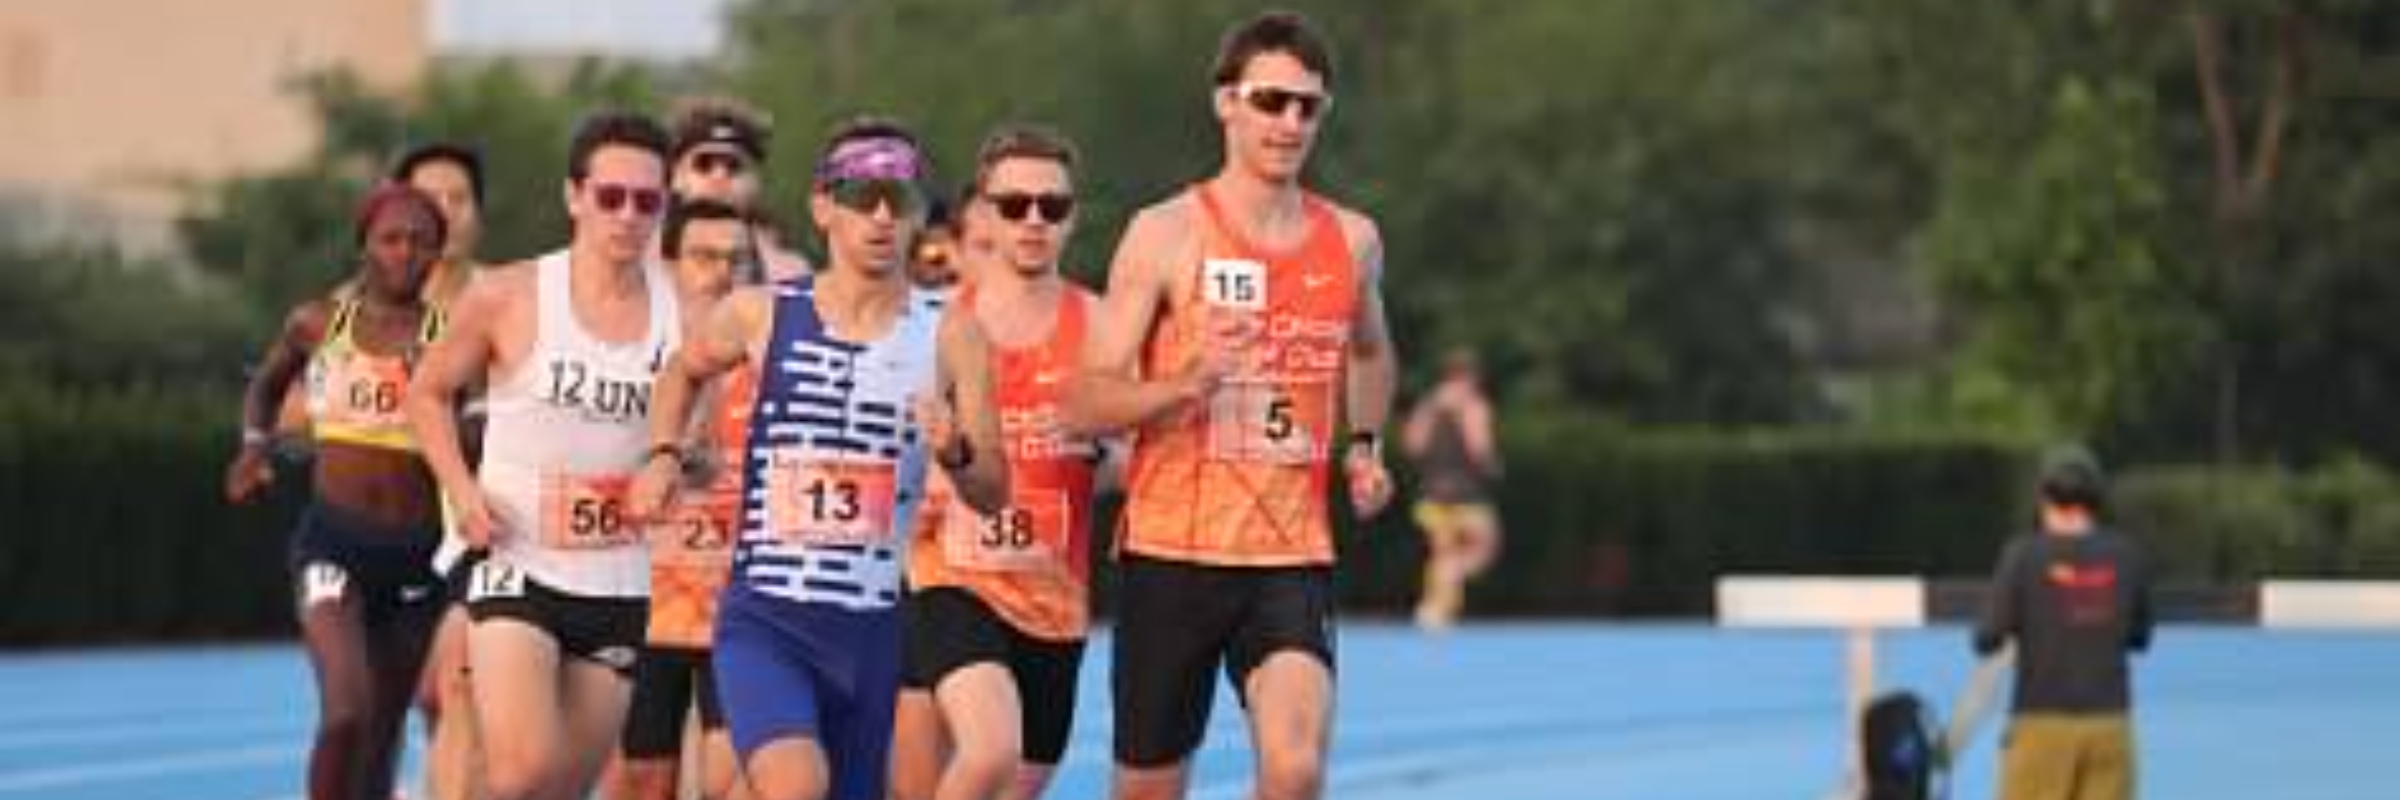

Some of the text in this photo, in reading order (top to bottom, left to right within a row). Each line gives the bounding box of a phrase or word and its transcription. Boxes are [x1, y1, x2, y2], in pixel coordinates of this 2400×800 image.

[1214, 272, 1257, 302] 15
[1265, 400, 1294, 441] 5
[572, 499, 620, 536] 56
[802, 479, 860, 521] 13
[980, 508, 1033, 549] 38
